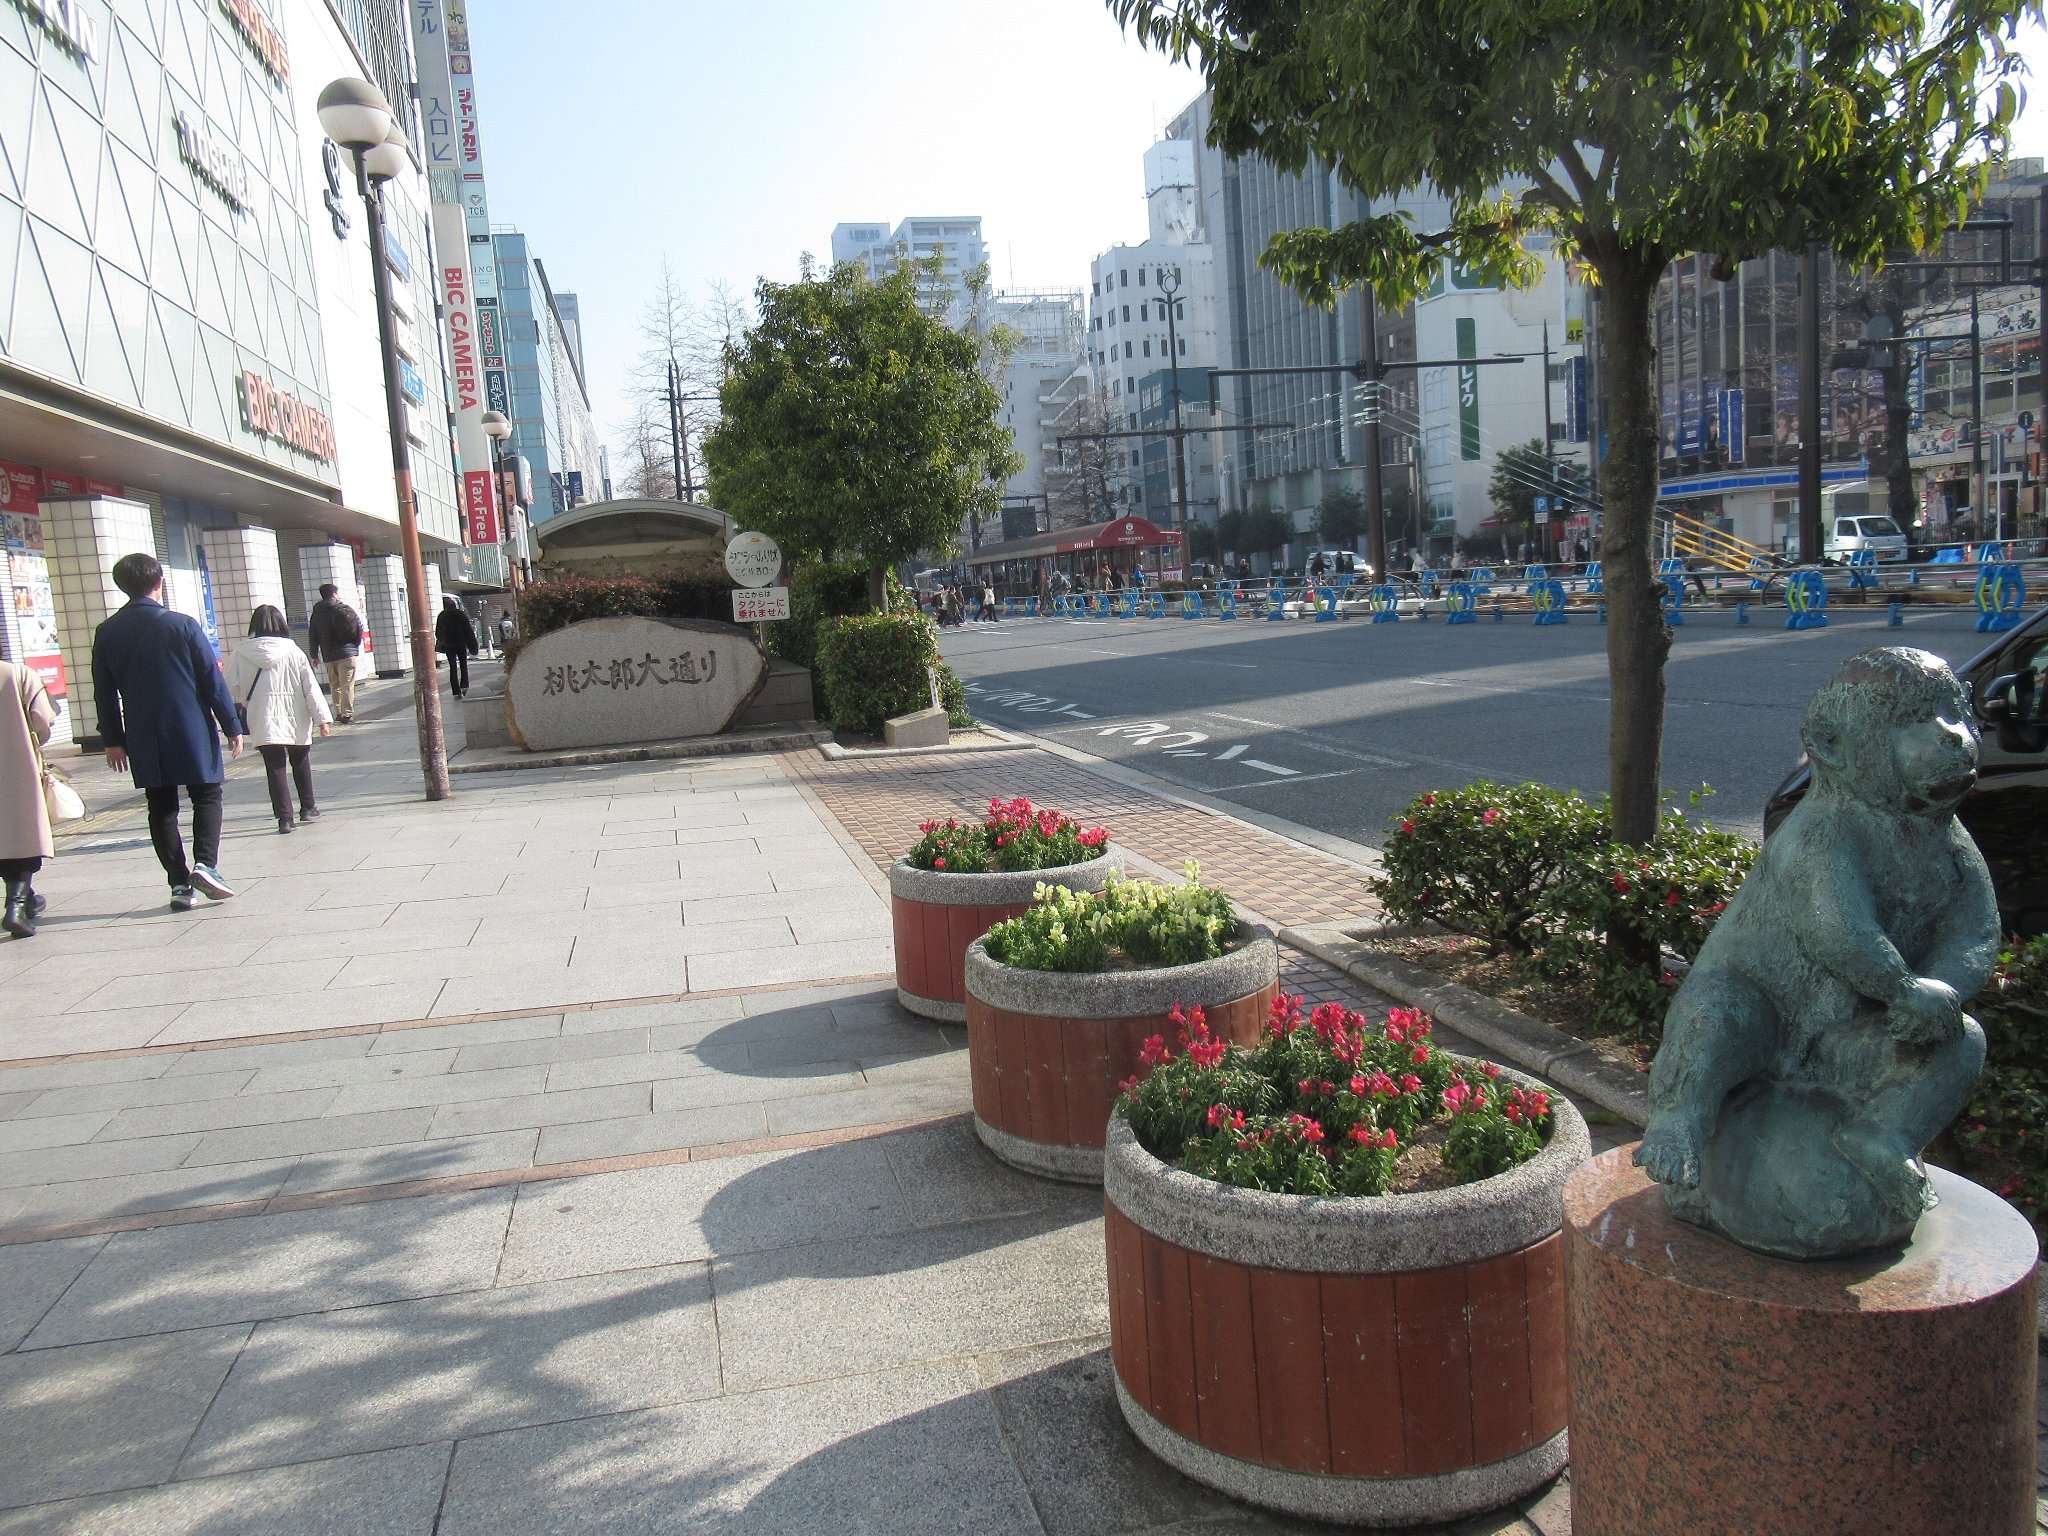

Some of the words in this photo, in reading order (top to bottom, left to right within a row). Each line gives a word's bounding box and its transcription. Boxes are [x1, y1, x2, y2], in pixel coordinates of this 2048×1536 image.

[428, 97, 449, 136] 入口
[457, 87, 479, 162] ジャンカラ
[468, 207, 485, 216] TCB
[444, 267, 466, 306] BIC
[1567, 329, 1583, 342] 4F
[450, 310, 477, 411] CAMERA
[487, 357, 500, 367] 2F
[242, 368, 275, 426] BIC
[270, 386, 337, 464] CAMERA
[471, 476, 485, 505] Tax
[474, 506, 488, 540] Free
[738, 591, 771, 600] ここからは
[738, 598, 785, 609] タクシーに
[738, 607, 786, 619] 乗れません
[543, 650, 717, 696] 桃太郎大通り
[1097, 722, 1303, 776] タクシー
